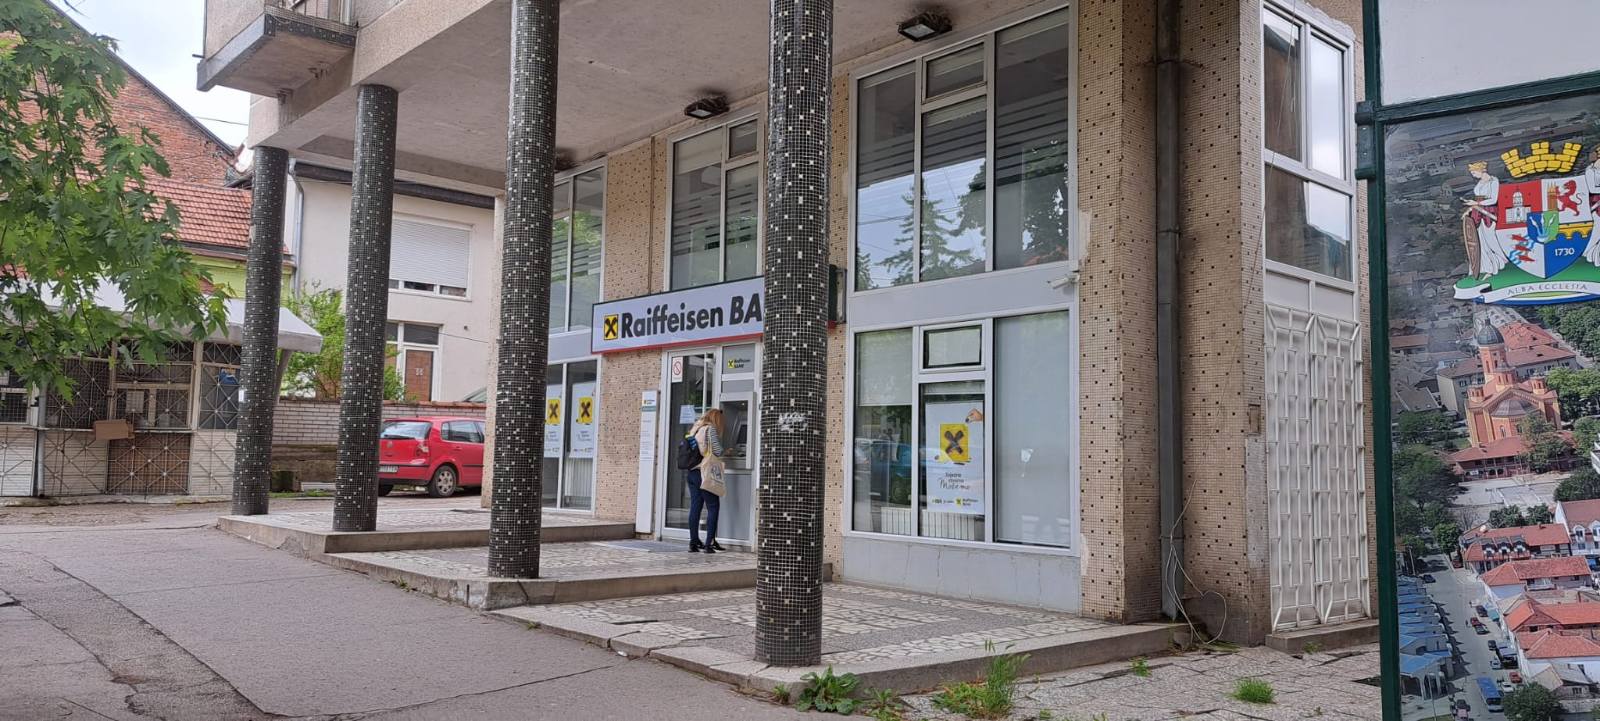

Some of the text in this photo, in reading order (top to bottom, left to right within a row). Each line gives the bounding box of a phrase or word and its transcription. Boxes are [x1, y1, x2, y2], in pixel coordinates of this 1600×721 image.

[1554, 247, 1575, 256] 1730
[1508, 286, 1534, 295] ALBA
[621, 293, 762, 338] Raiffeisen BA
